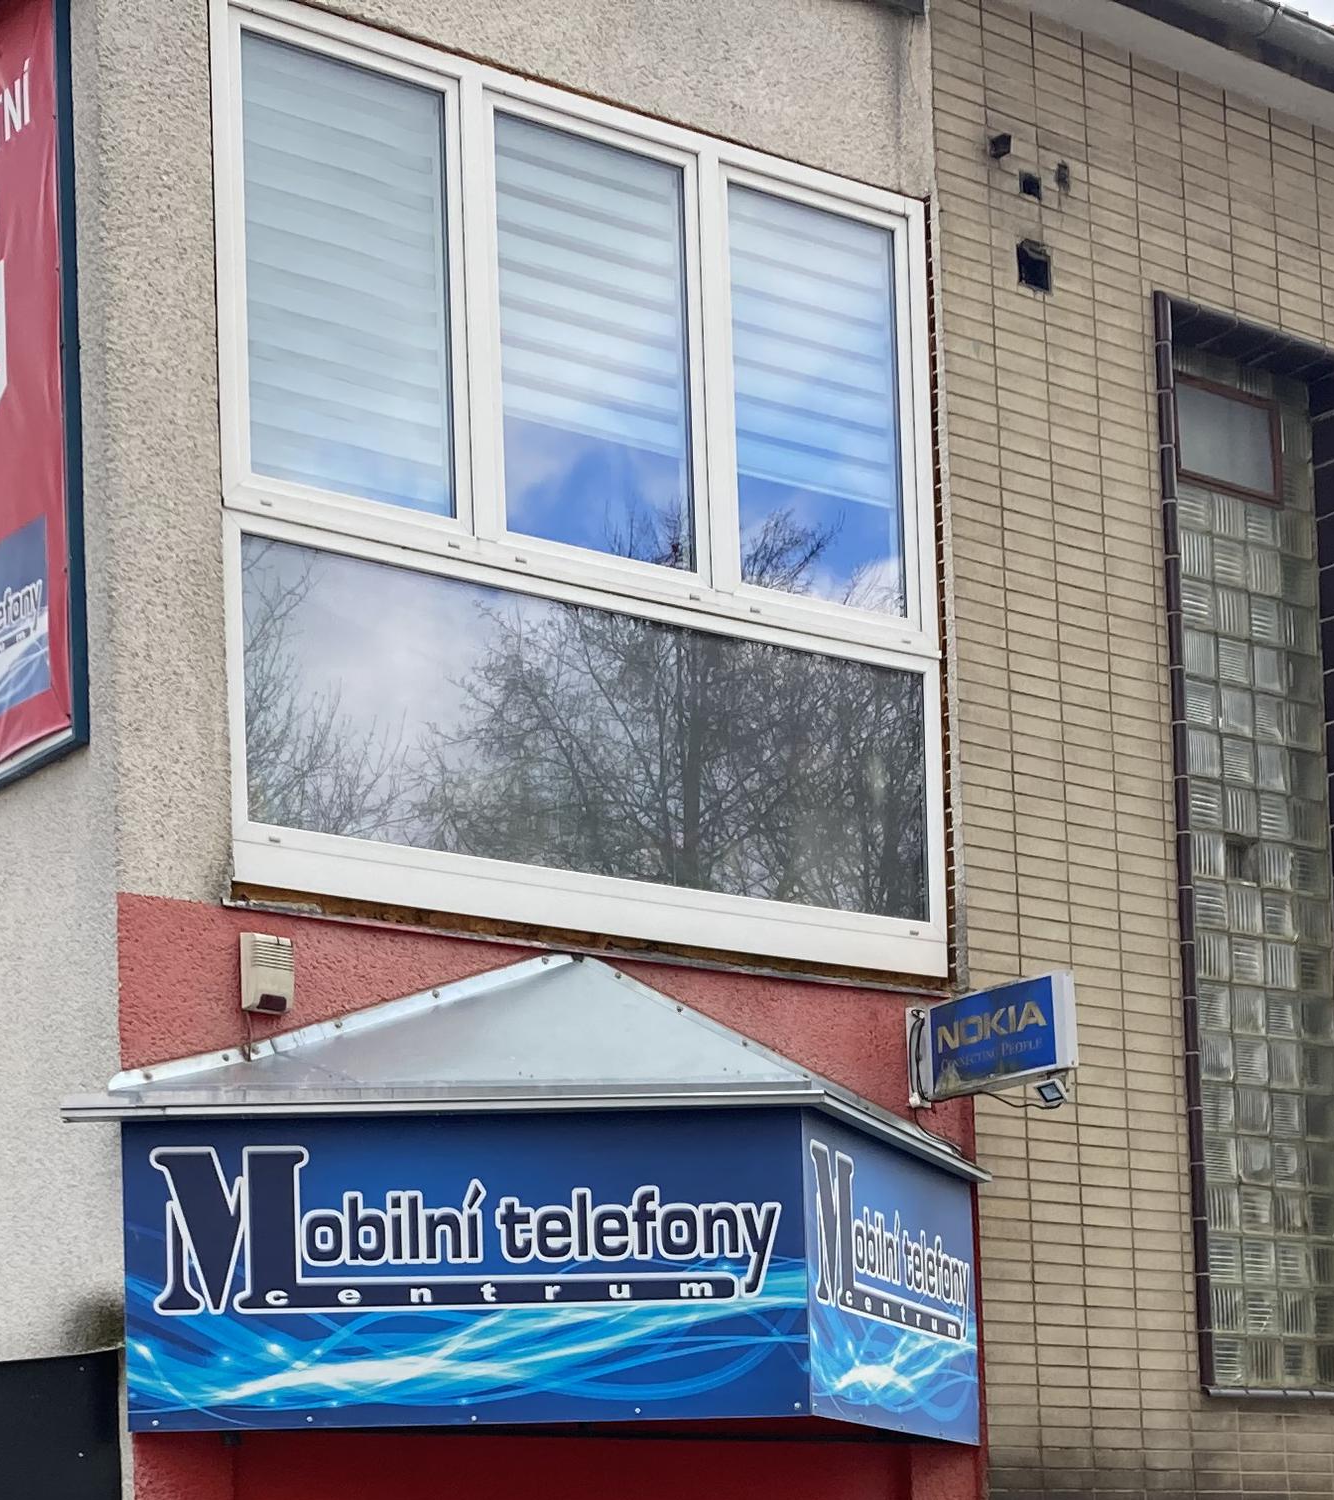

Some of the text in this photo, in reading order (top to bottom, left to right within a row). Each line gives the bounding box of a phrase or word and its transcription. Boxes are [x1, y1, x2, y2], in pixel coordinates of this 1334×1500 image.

[937, 1001, 1048, 1054] NOKIA
[150, 1145, 782, 1316] Mobilní telefony
[810, 1139, 970, 1341] Mobilní telefony
[264, 1278, 716, 1307] centrum
[844, 1288, 958, 1338] centrum
